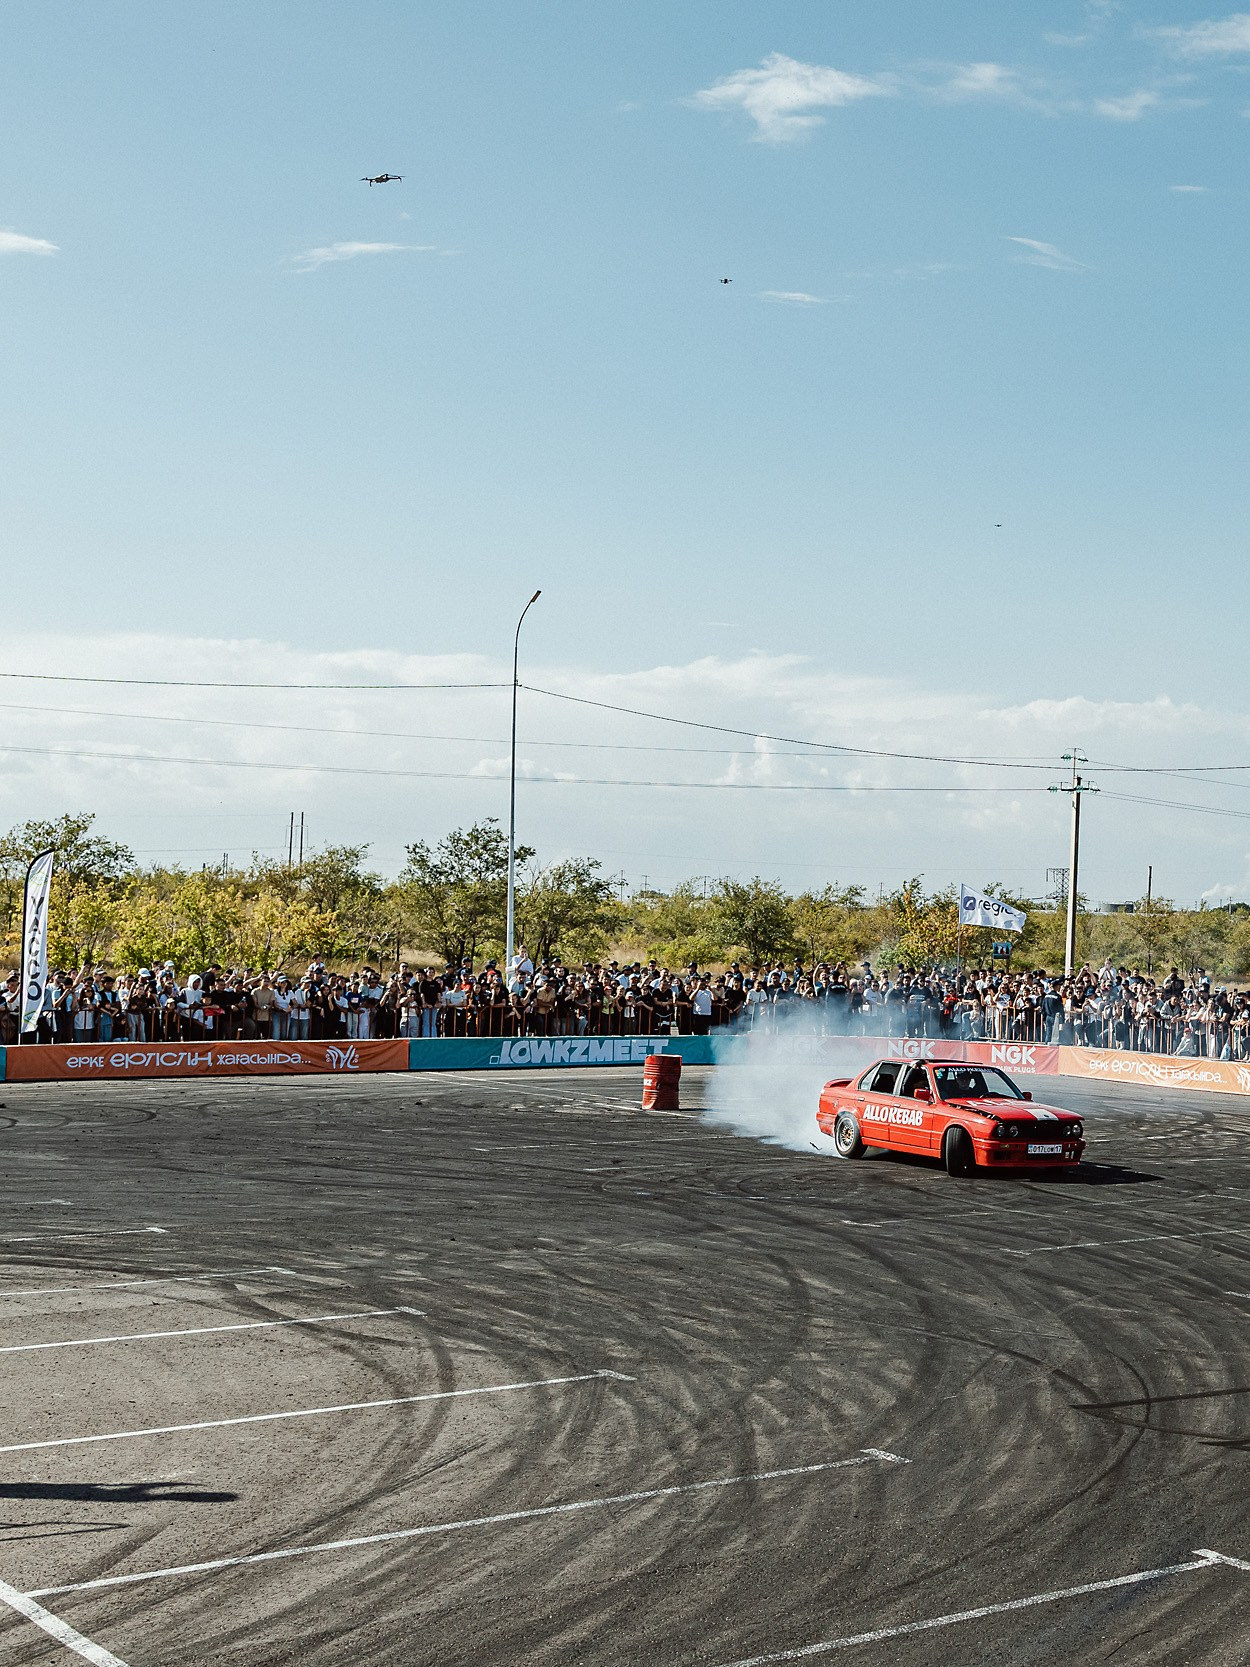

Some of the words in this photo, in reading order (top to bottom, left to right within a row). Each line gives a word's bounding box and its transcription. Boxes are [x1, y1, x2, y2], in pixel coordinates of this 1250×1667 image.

[27, 895, 45, 1001] YACCO
[887, 1040, 936, 1059] NGK
[991, 1045, 1037, 1065] NGK
